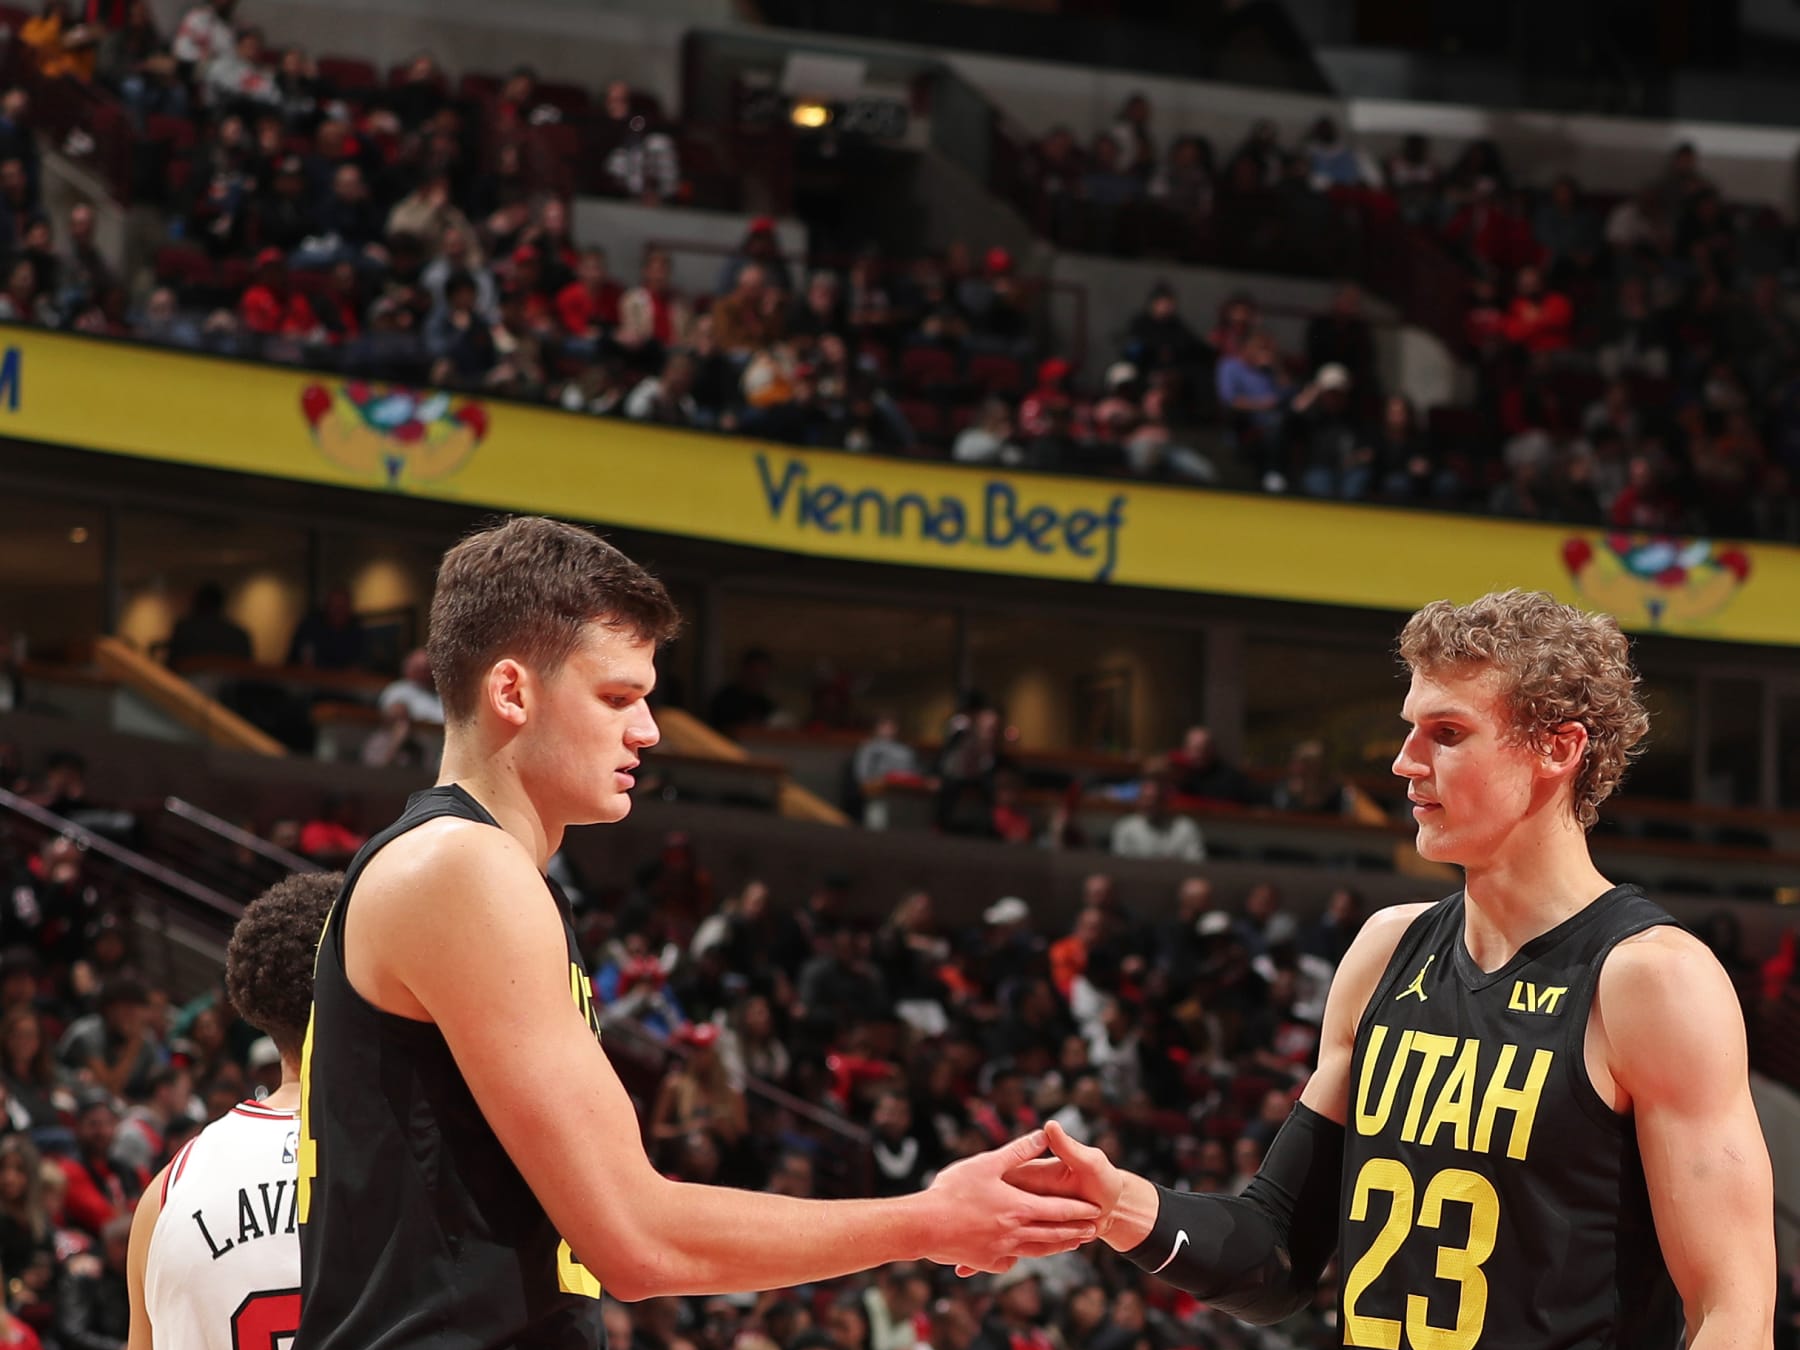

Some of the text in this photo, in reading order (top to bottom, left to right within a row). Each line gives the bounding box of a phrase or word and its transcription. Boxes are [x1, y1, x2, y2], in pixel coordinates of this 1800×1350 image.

[756, 452, 1127, 583] Vienna Beef
[1508, 981, 1568, 1014] LVT
[1355, 1024, 1554, 1161] UTAH
